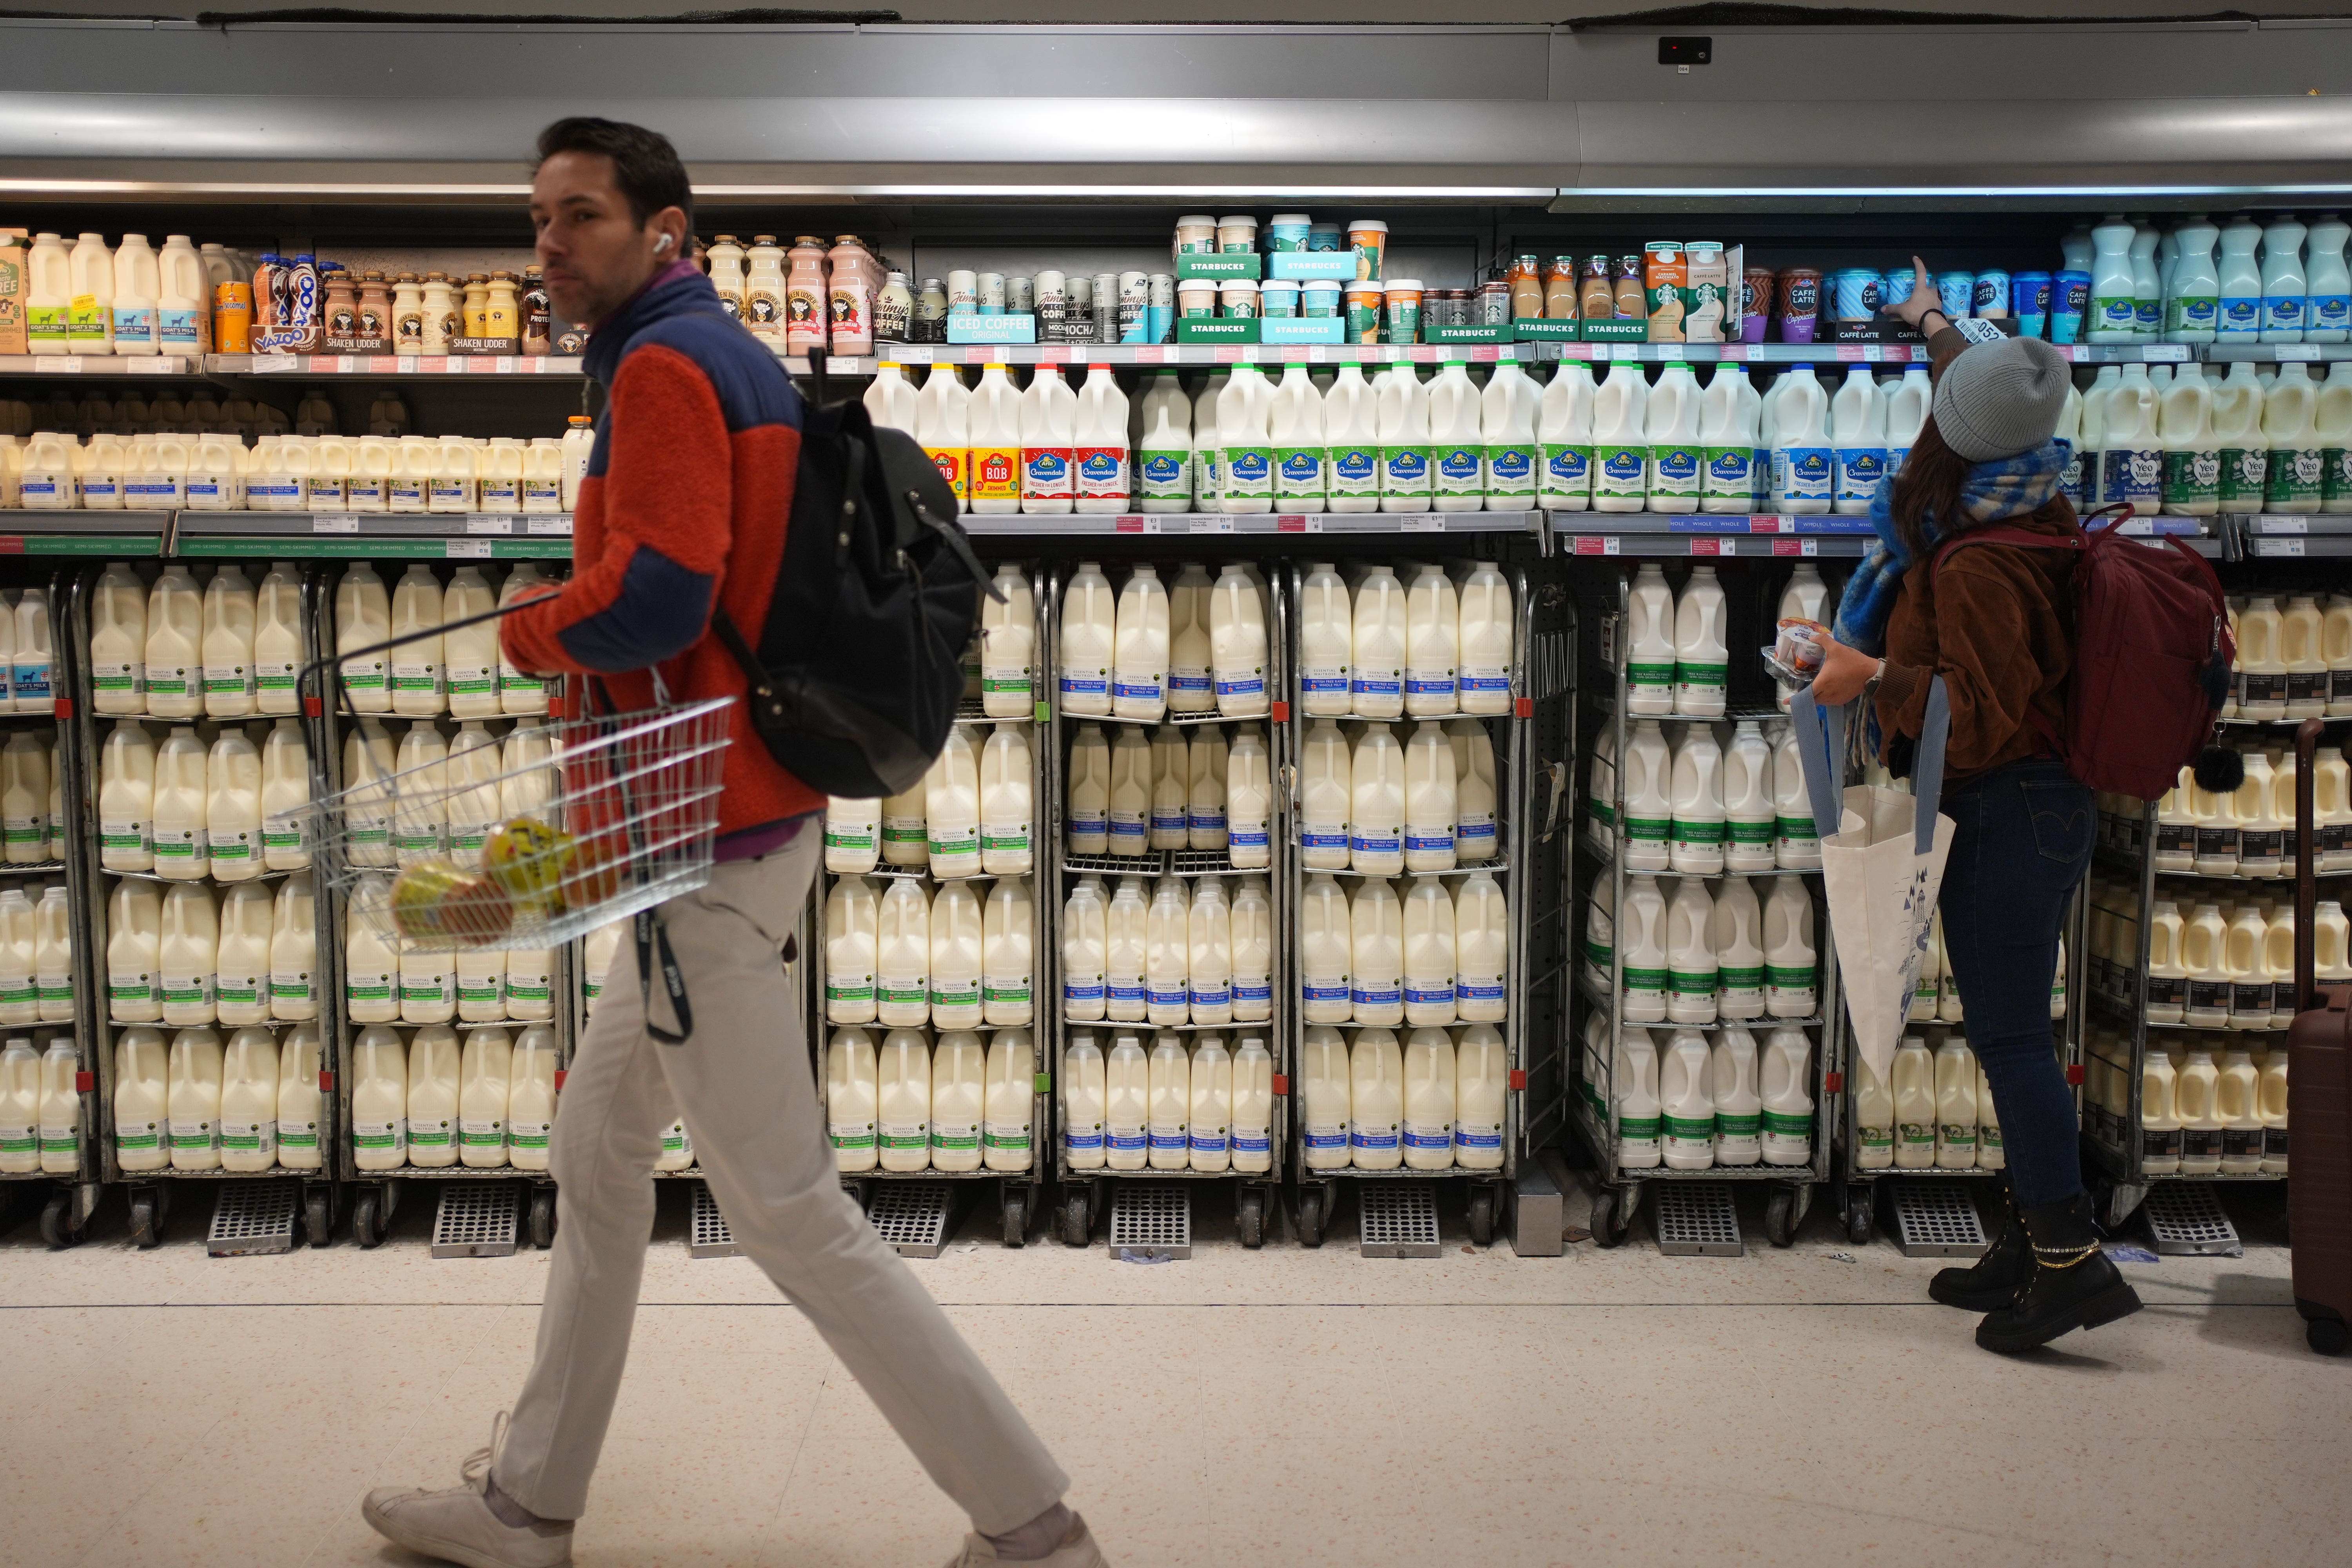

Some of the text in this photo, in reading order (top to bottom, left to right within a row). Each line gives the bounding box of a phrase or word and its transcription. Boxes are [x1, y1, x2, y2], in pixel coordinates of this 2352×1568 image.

[728, 292, 742, 306] UDDER
[747, 291, 779, 306] SHAKEN UDDER
[800, 291, 817, 305] UDDER
[840, 293, 857, 305] UDDER
[330, 308, 345, 318] SHAKEN
[953, 318, 1029, 330] ICED COFFEE
[1519, 324, 1573, 332] STARBUCKS
[972, 331, 1010, 339] ORIGINAL
[1978, 322, 1999, 341] 052
[256, 329, 303, 349] YAZOO
[295, 339, 316, 348] CHOCOLATE
[327, 338, 380, 348] SHAKEN UDDER
[454, 338, 507, 348] SHAKEN UDDER
[2200, 463, 2214, 472] Yeo
[2301, 462, 2317, 470] Yeo
[987, 467, 1007, 479] B.O.B
